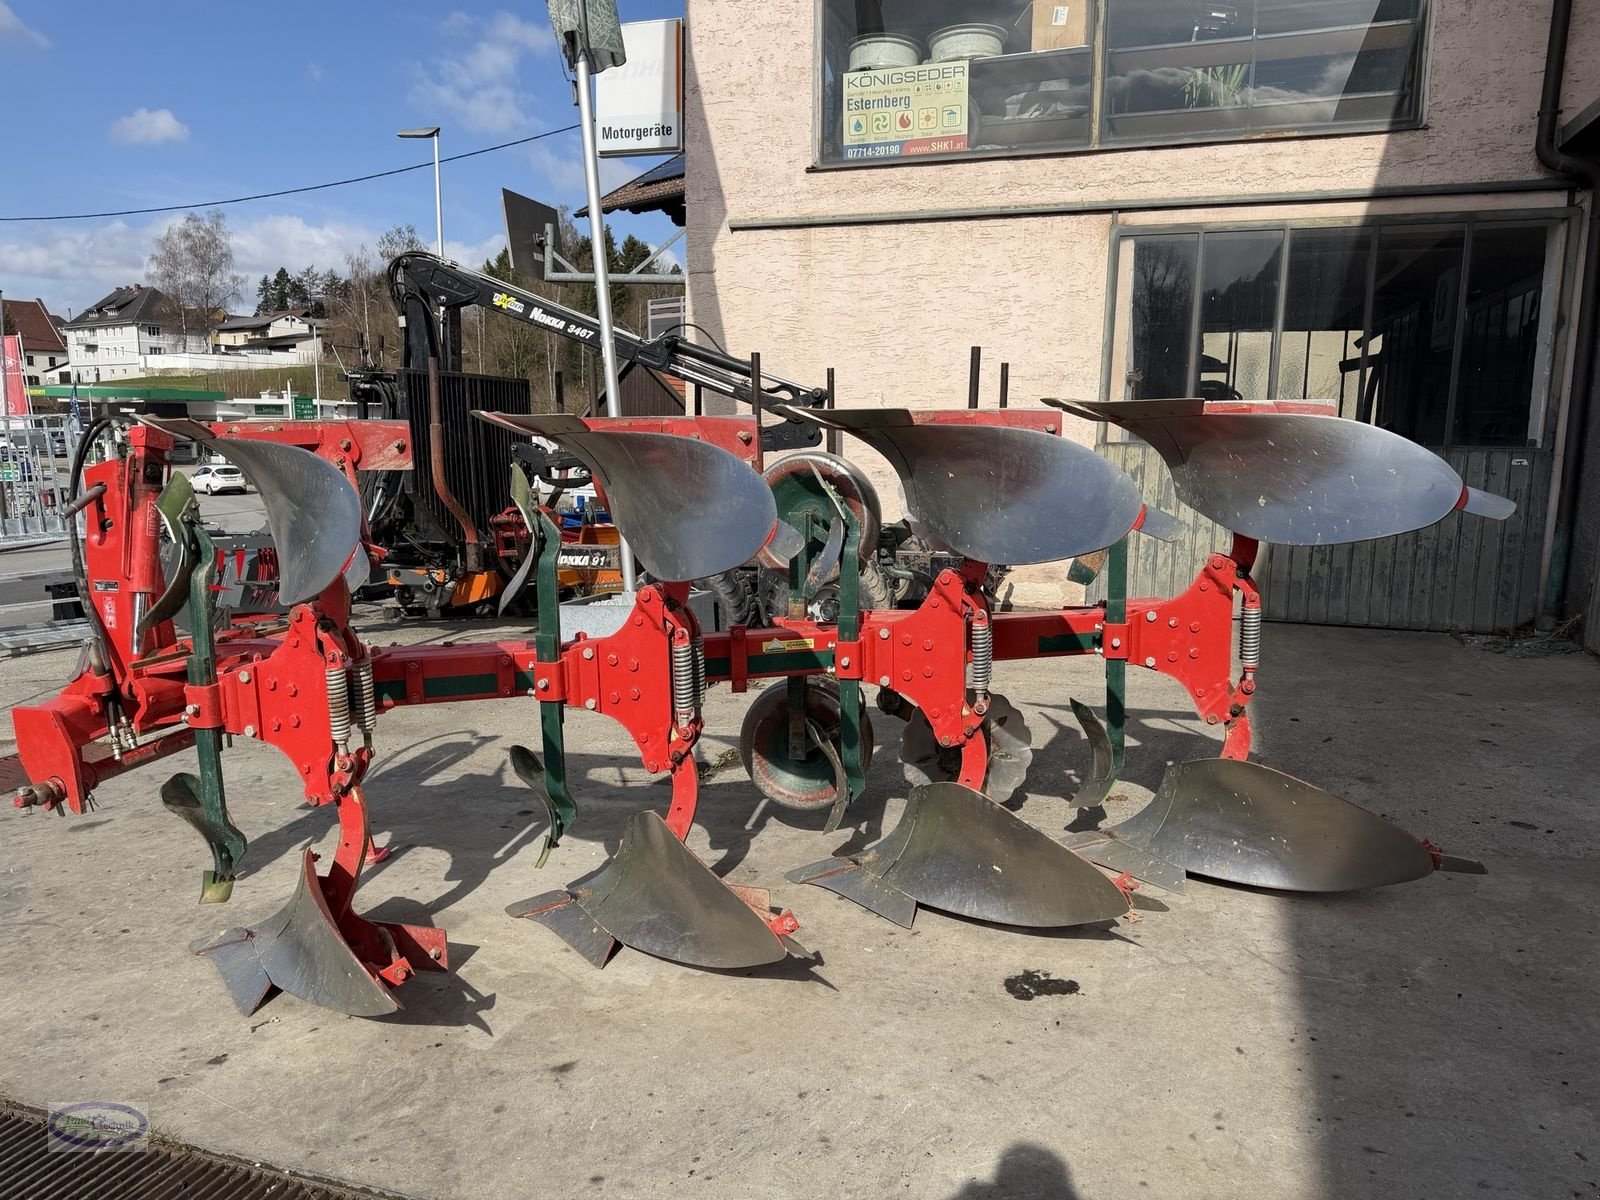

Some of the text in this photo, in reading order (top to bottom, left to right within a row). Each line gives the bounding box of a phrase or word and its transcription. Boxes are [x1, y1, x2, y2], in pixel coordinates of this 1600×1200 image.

[847, 65, 965, 88] KÖNIGSEDER
[847, 95, 911, 111] Esternberg
[602, 123, 673, 140] Motorgeräte
[847, 140, 964, 158] 07714-20190 www.SHK1.at
[529, 307, 566, 330] NOKKA
[567, 324, 595, 339] 3467
[592, 556, 606, 566] 91
